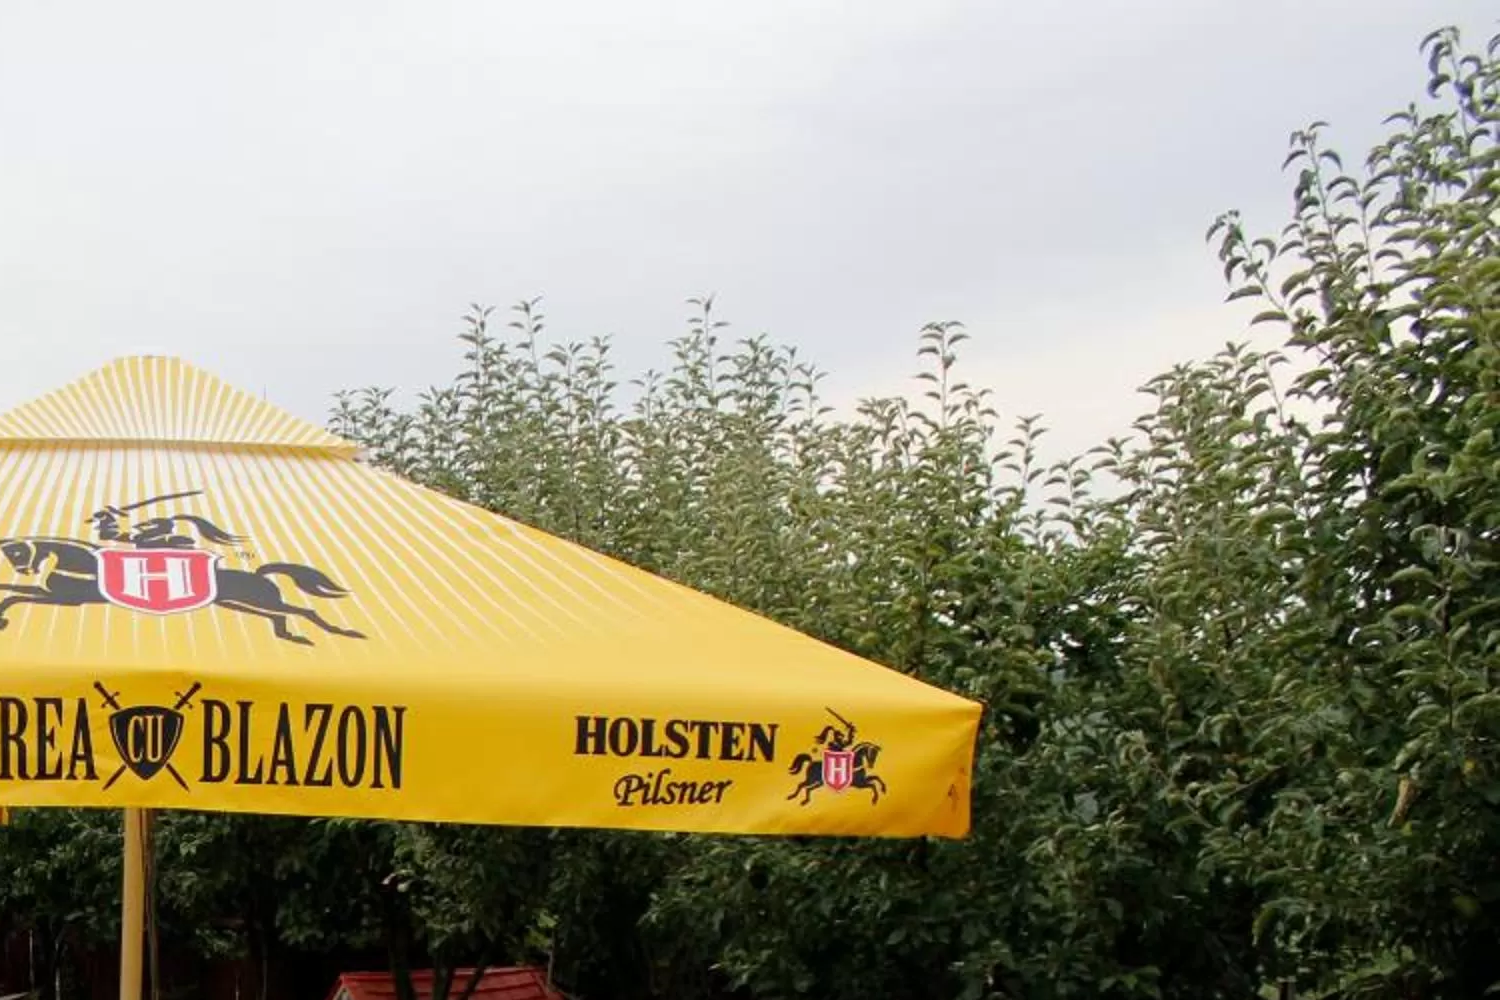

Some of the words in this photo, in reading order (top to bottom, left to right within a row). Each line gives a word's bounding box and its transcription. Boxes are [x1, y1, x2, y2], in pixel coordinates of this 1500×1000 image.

[121, 556, 196, 601] H
[127, 714, 164, 763] CU
[199, 699, 406, 789] BLAZON
[573, 716, 778, 762] HOLSTEN
[613, 769, 732, 807] Pilsner
[831, 757, 848, 784] H
